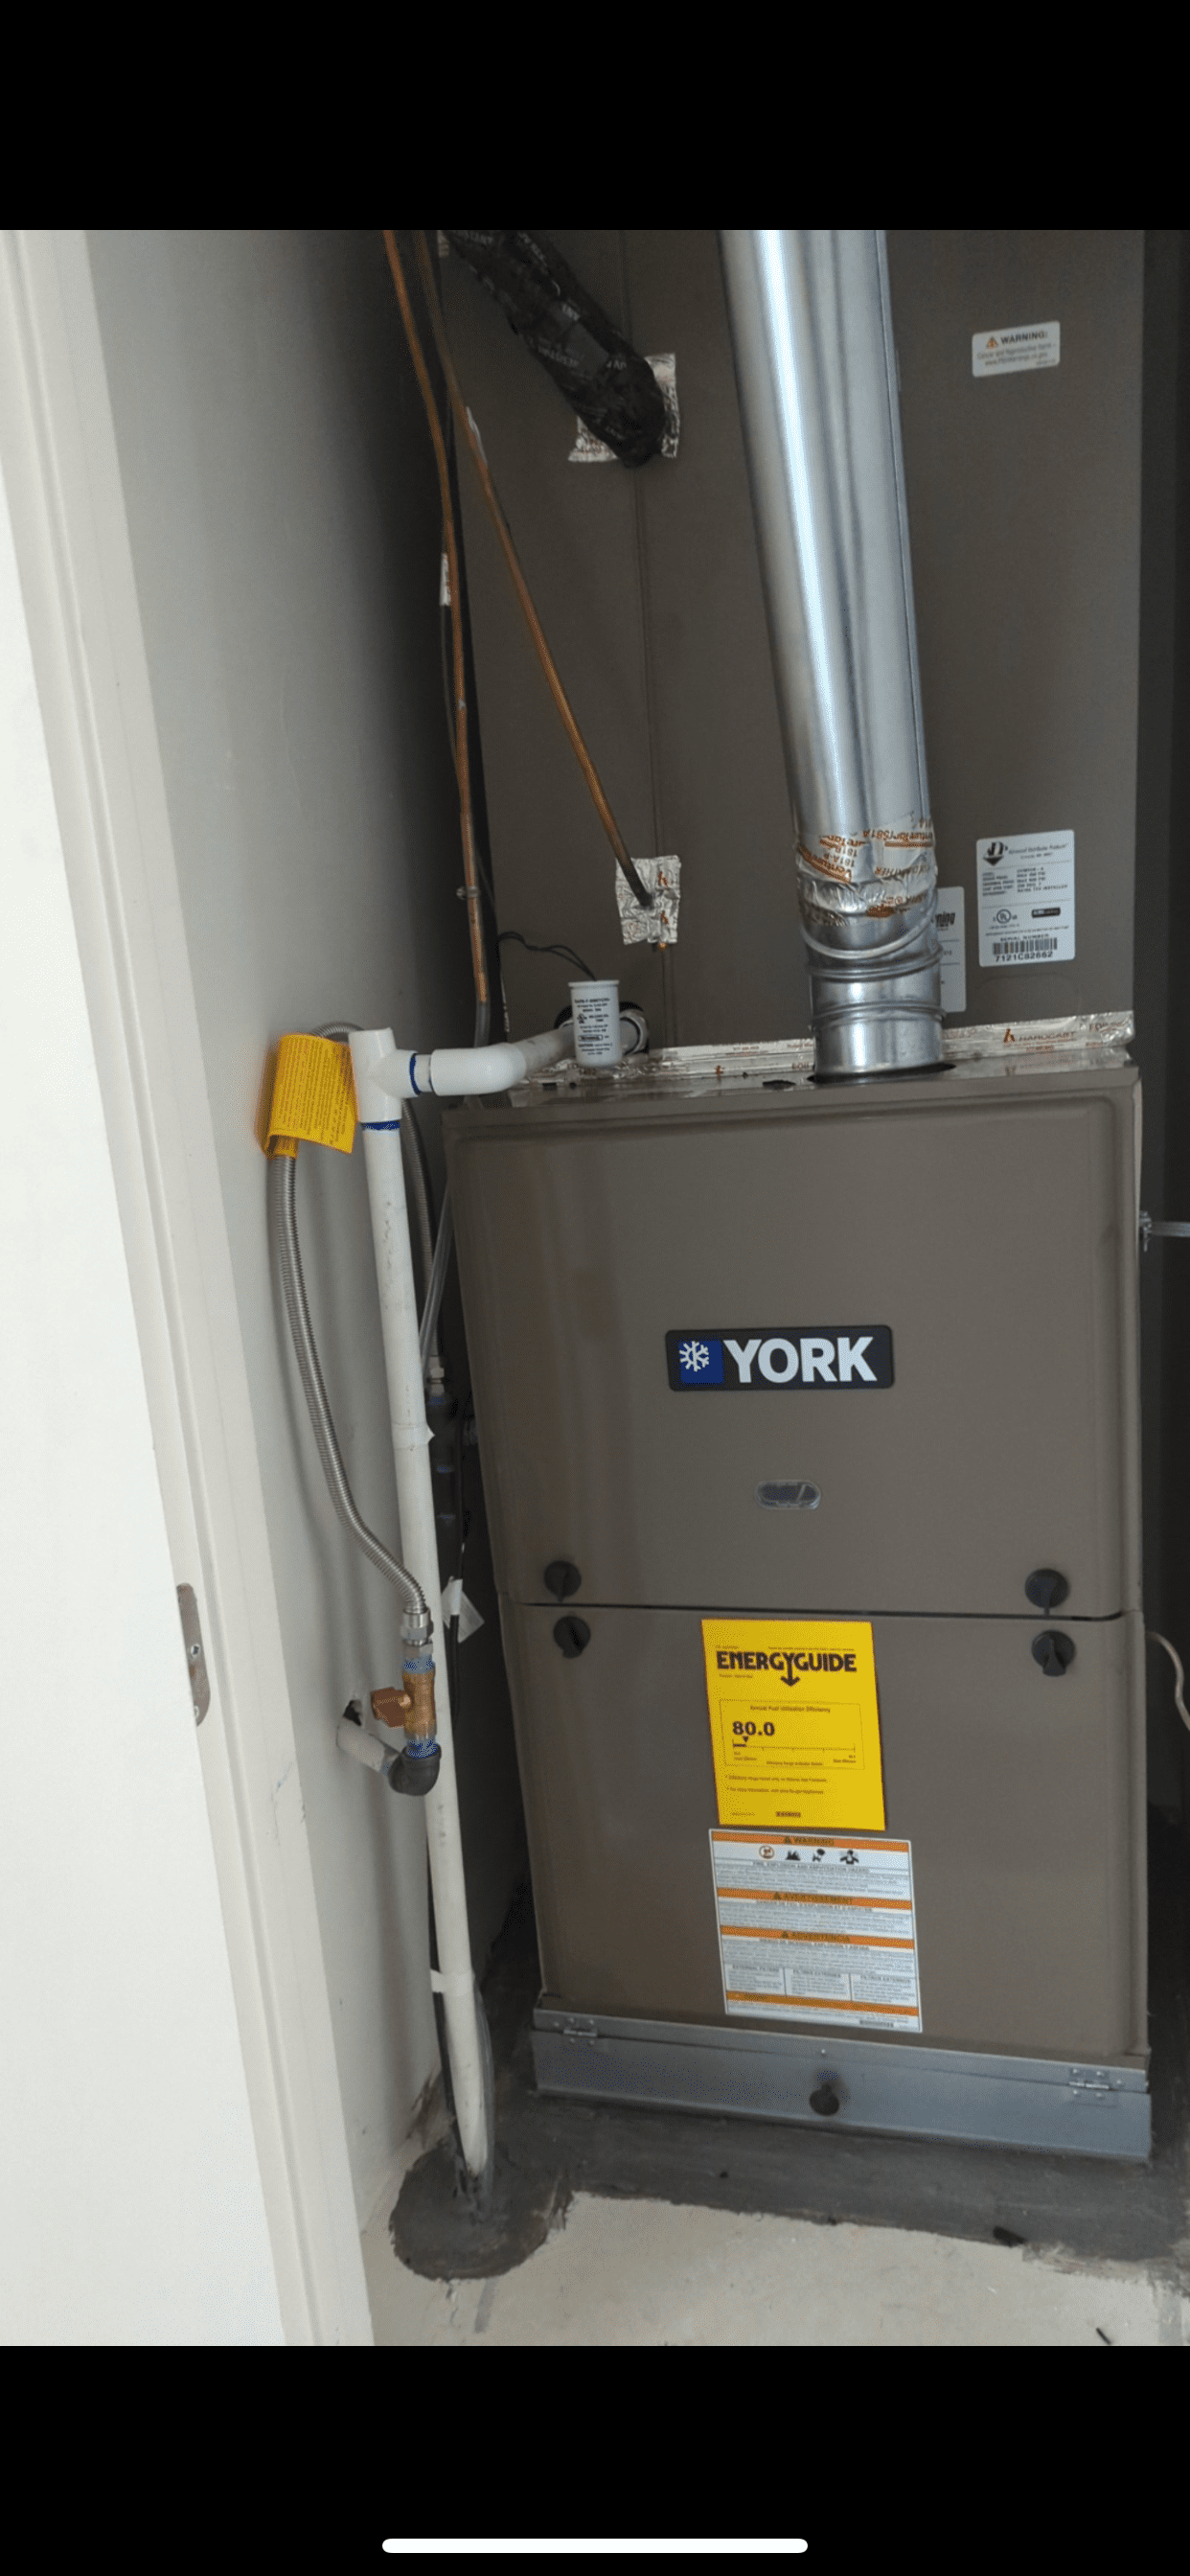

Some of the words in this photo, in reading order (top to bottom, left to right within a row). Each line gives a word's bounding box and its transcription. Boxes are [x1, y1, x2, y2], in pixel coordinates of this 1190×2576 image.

[1000, 330, 1048, 345] WARNING:
[722, 1336, 878, 1384] YORK
[716, 1650, 857, 1673] ENERGYGUIDE
[732, 1720, 775, 1736] 80.0
